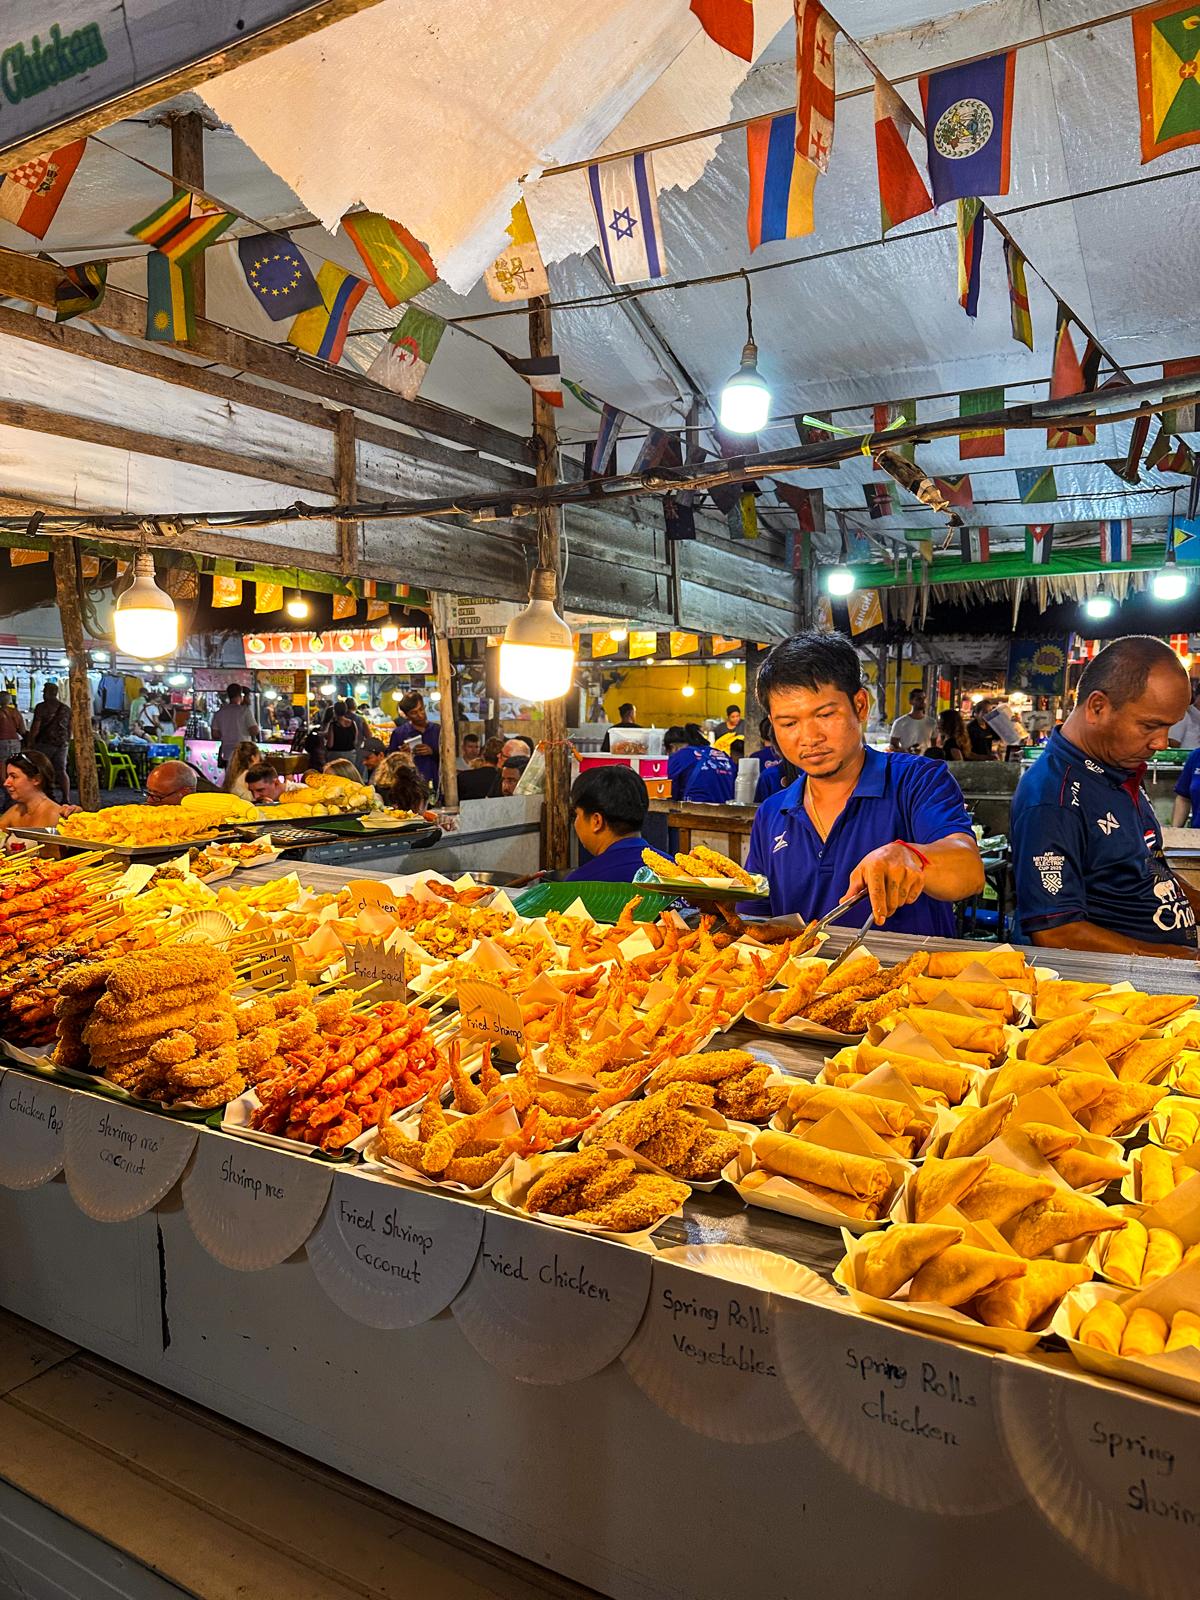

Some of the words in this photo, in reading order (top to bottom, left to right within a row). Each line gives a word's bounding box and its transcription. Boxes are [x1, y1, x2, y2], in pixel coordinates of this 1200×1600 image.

[1, 21, 108, 105] Chicken
[353, 961, 378, 979] Fried
[466, 1015, 490, 1031] Fried
[219, 1154, 262, 1200] Shrimp
[340, 1200, 376, 1232] Fried
[382, 1207, 433, 1255] Shrimp
[481, 1241, 529, 1281] Fried
[663, 1289, 719, 1330] Spring
[672, 1333, 777, 1378] Vegetables
[846, 1348, 907, 1389] Spring
[1089, 1421, 1176, 1477] Spring
